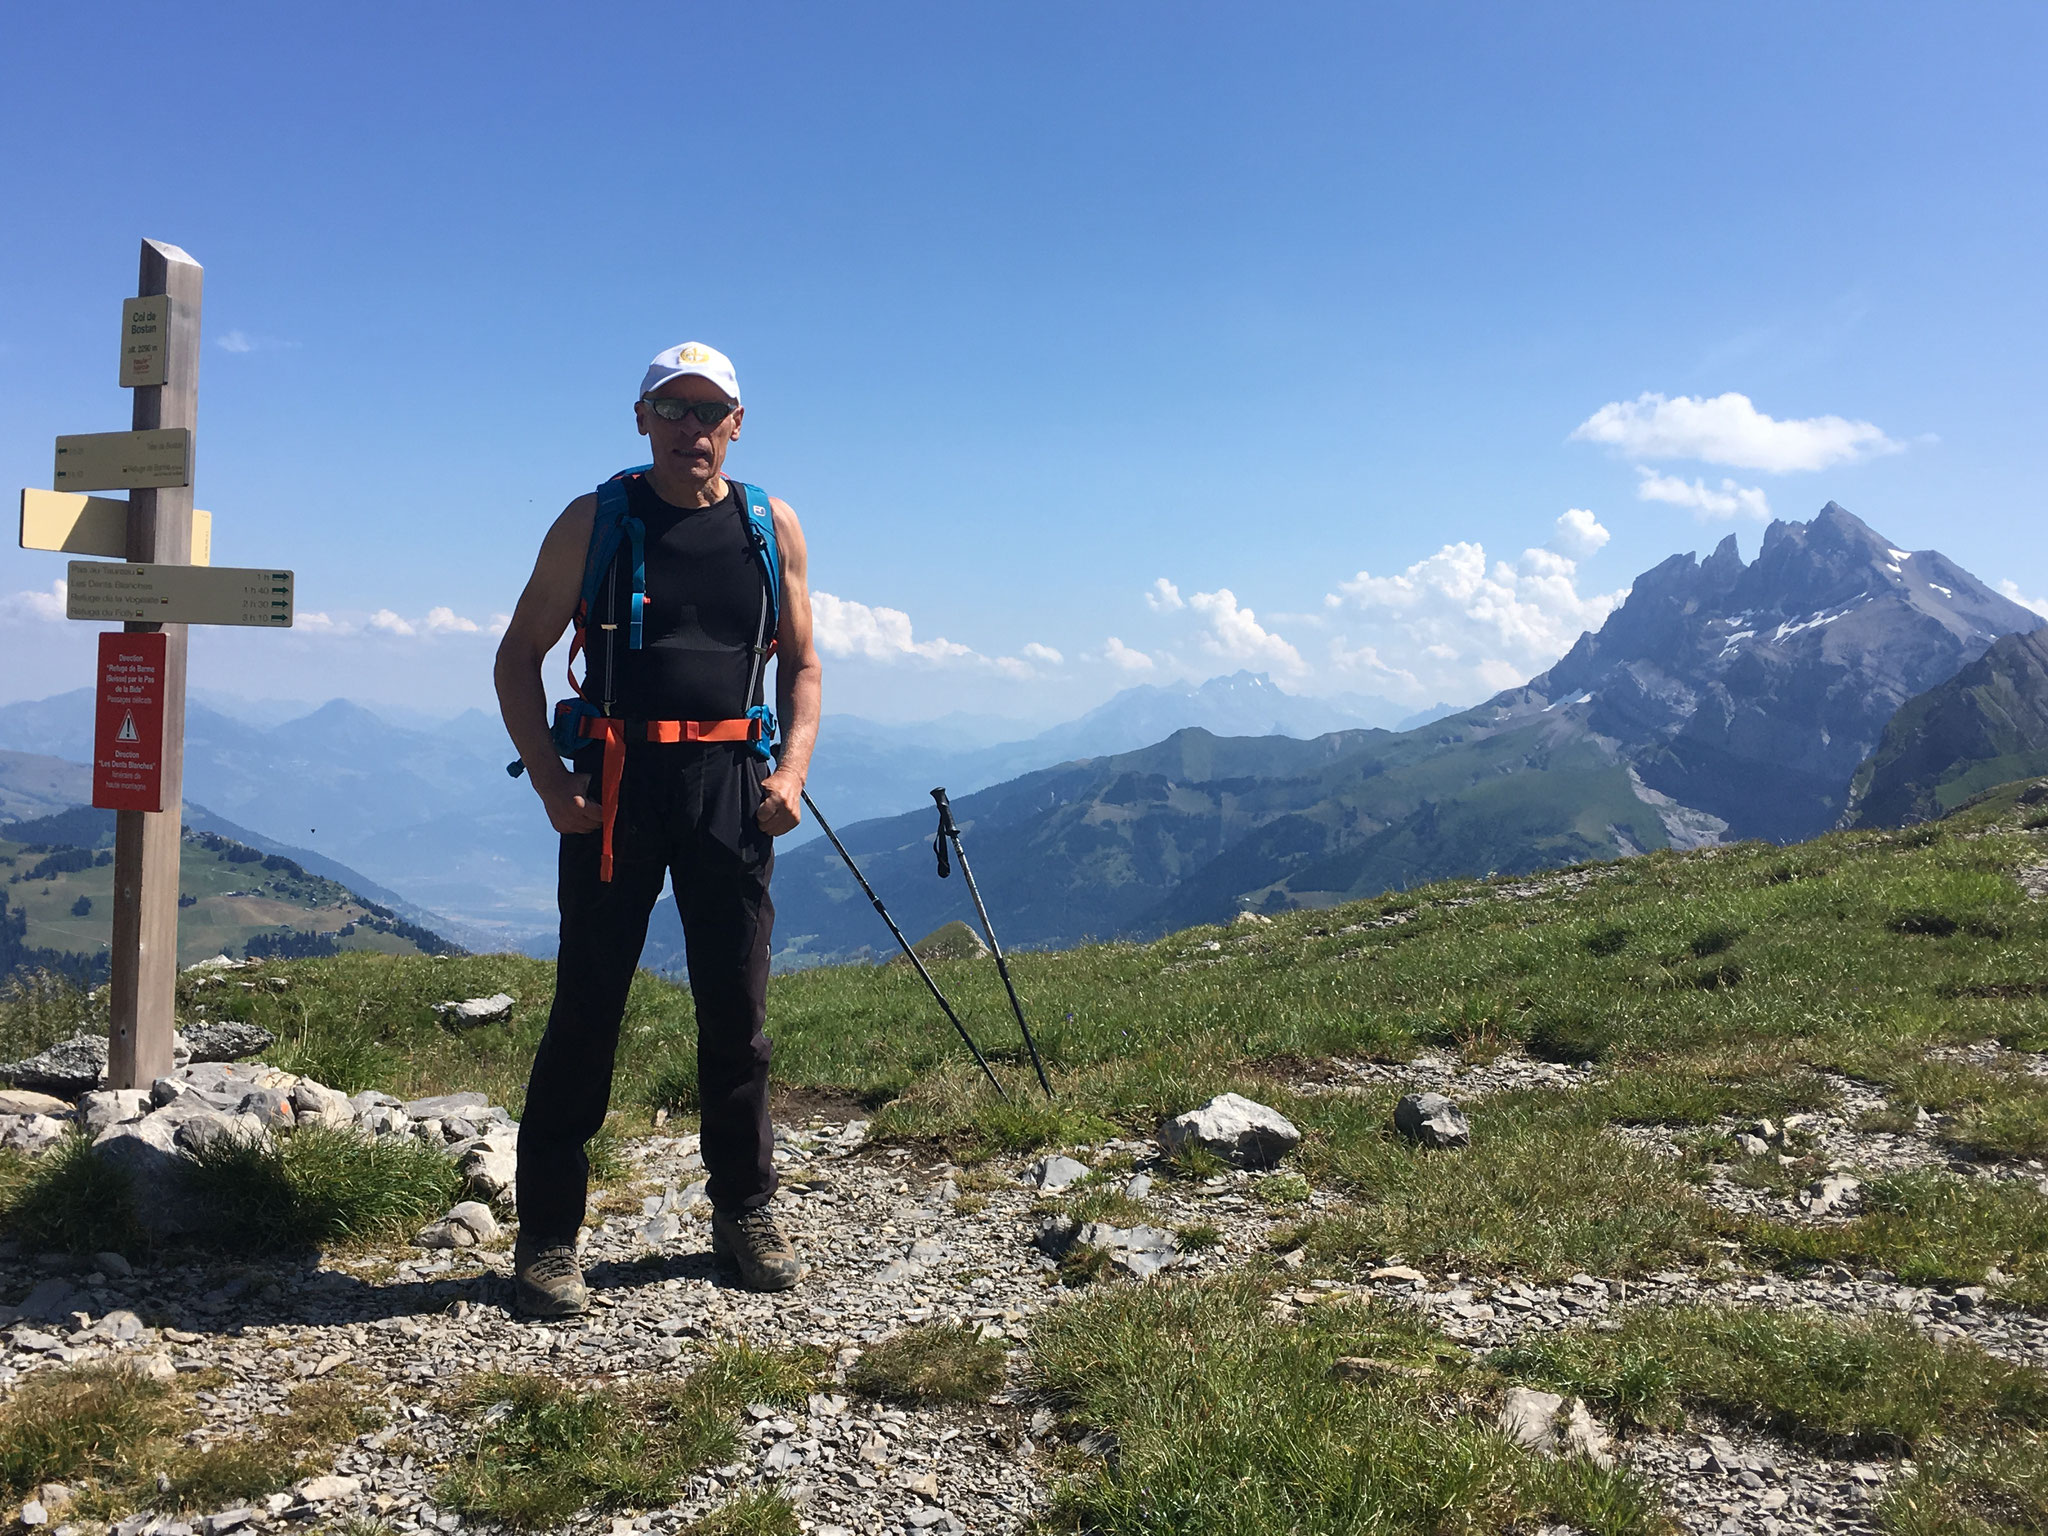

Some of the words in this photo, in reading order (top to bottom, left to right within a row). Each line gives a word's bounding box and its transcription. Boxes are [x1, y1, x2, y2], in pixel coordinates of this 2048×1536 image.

[133, 312, 145, 322] Col
[146, 312, 156, 321] de
[131, 325, 156, 334] Bostan
[71, 565, 87, 574] Pas
[71, 580, 86, 588] Les
[88, 580, 112, 588] Dents
[115, 581, 153, 590] Blanches
[71, 593, 98, 602] Refuge
[250, 600, 256, 608] h
[258, 600, 269, 608] 30
[71, 607, 99, 617] Refuge
[102, 608, 112, 616] du
[115, 609, 133, 617] Folly
[258, 614, 268, 622] 10
[119, 654, 143, 662] Direction
[128, 676, 137, 684] par
[144, 675, 154, 683] Pas
[115, 685, 122, 693] de
[115, 750, 139, 758] Direction
[112, 760, 127, 769] Dents
[106, 781, 120, 789] haute
[121, 783, 146, 792] montagne
